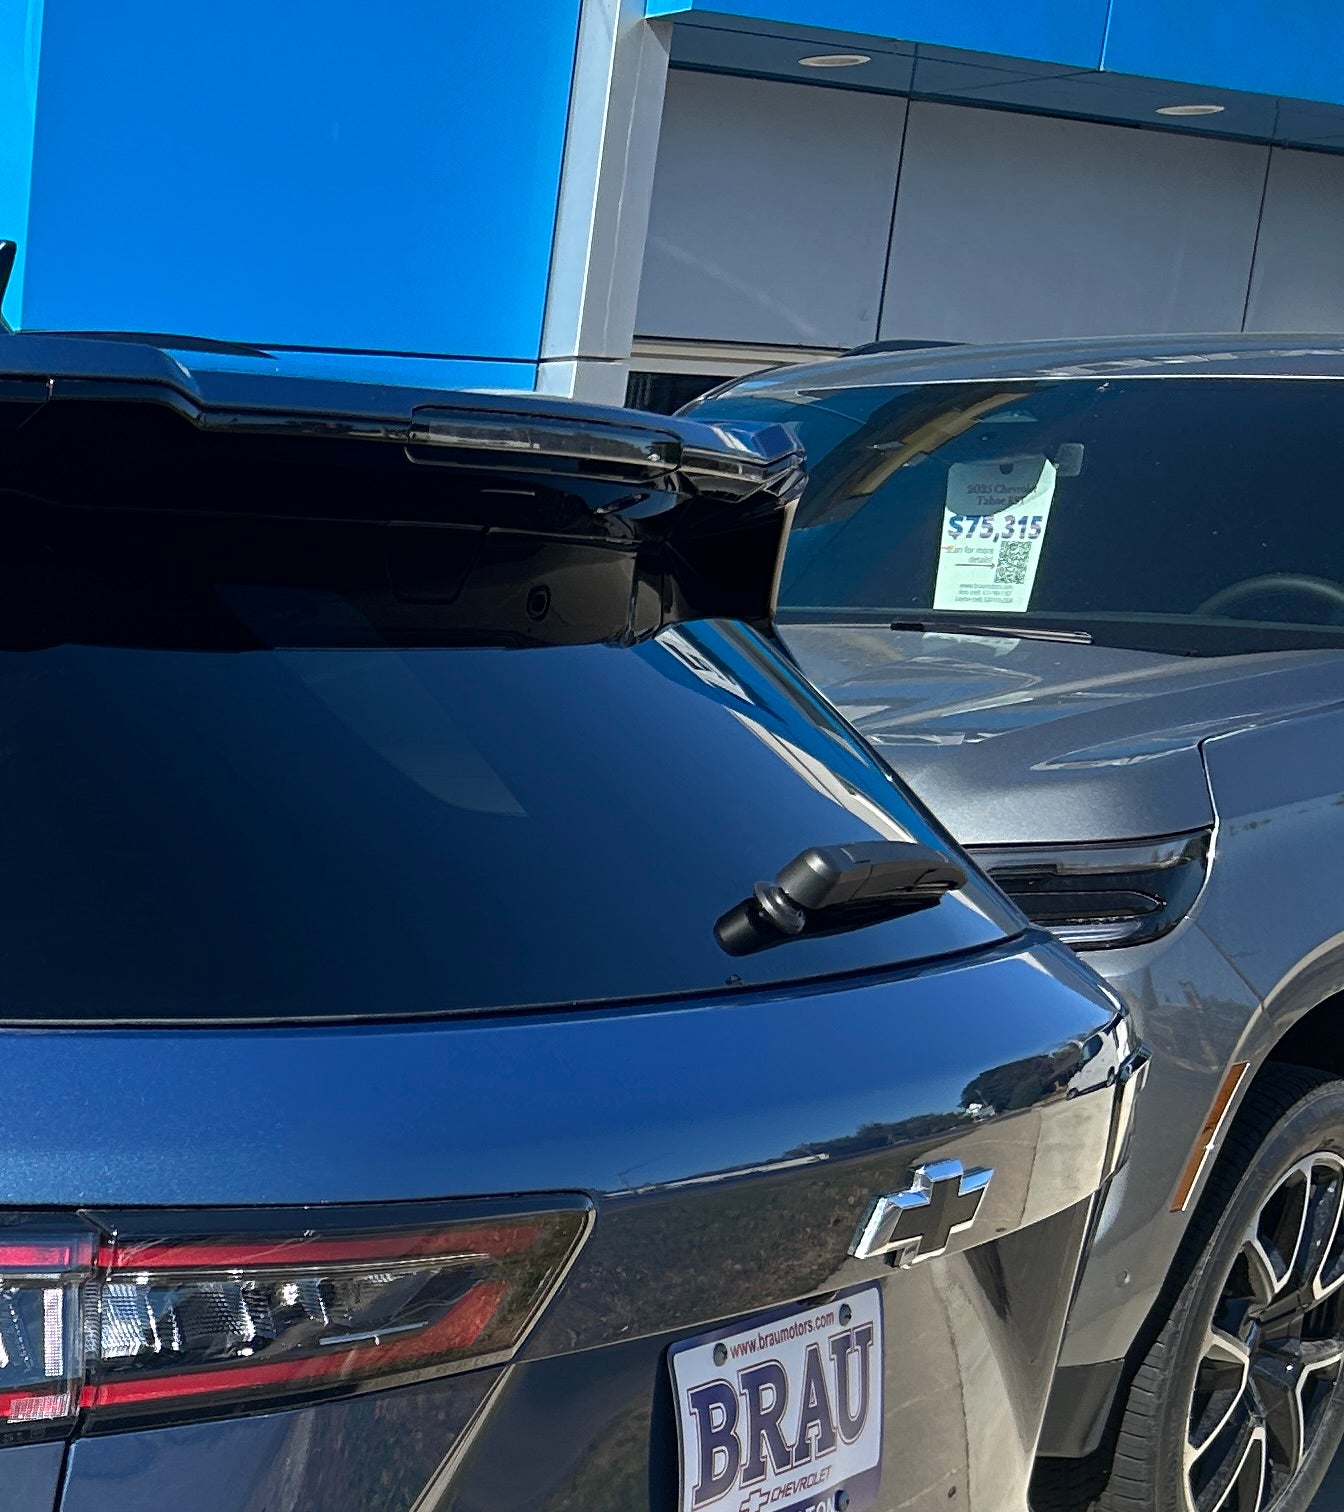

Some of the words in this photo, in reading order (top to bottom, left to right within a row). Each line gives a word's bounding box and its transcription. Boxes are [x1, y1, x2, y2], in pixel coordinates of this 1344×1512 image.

[948, 515, 1043, 543] $75,315
[729, 1311, 835, 1359] www.braumotors.com
[686, 1320, 875, 1512] BRAU
[770, 1465, 833, 1503] CHEVROLET
